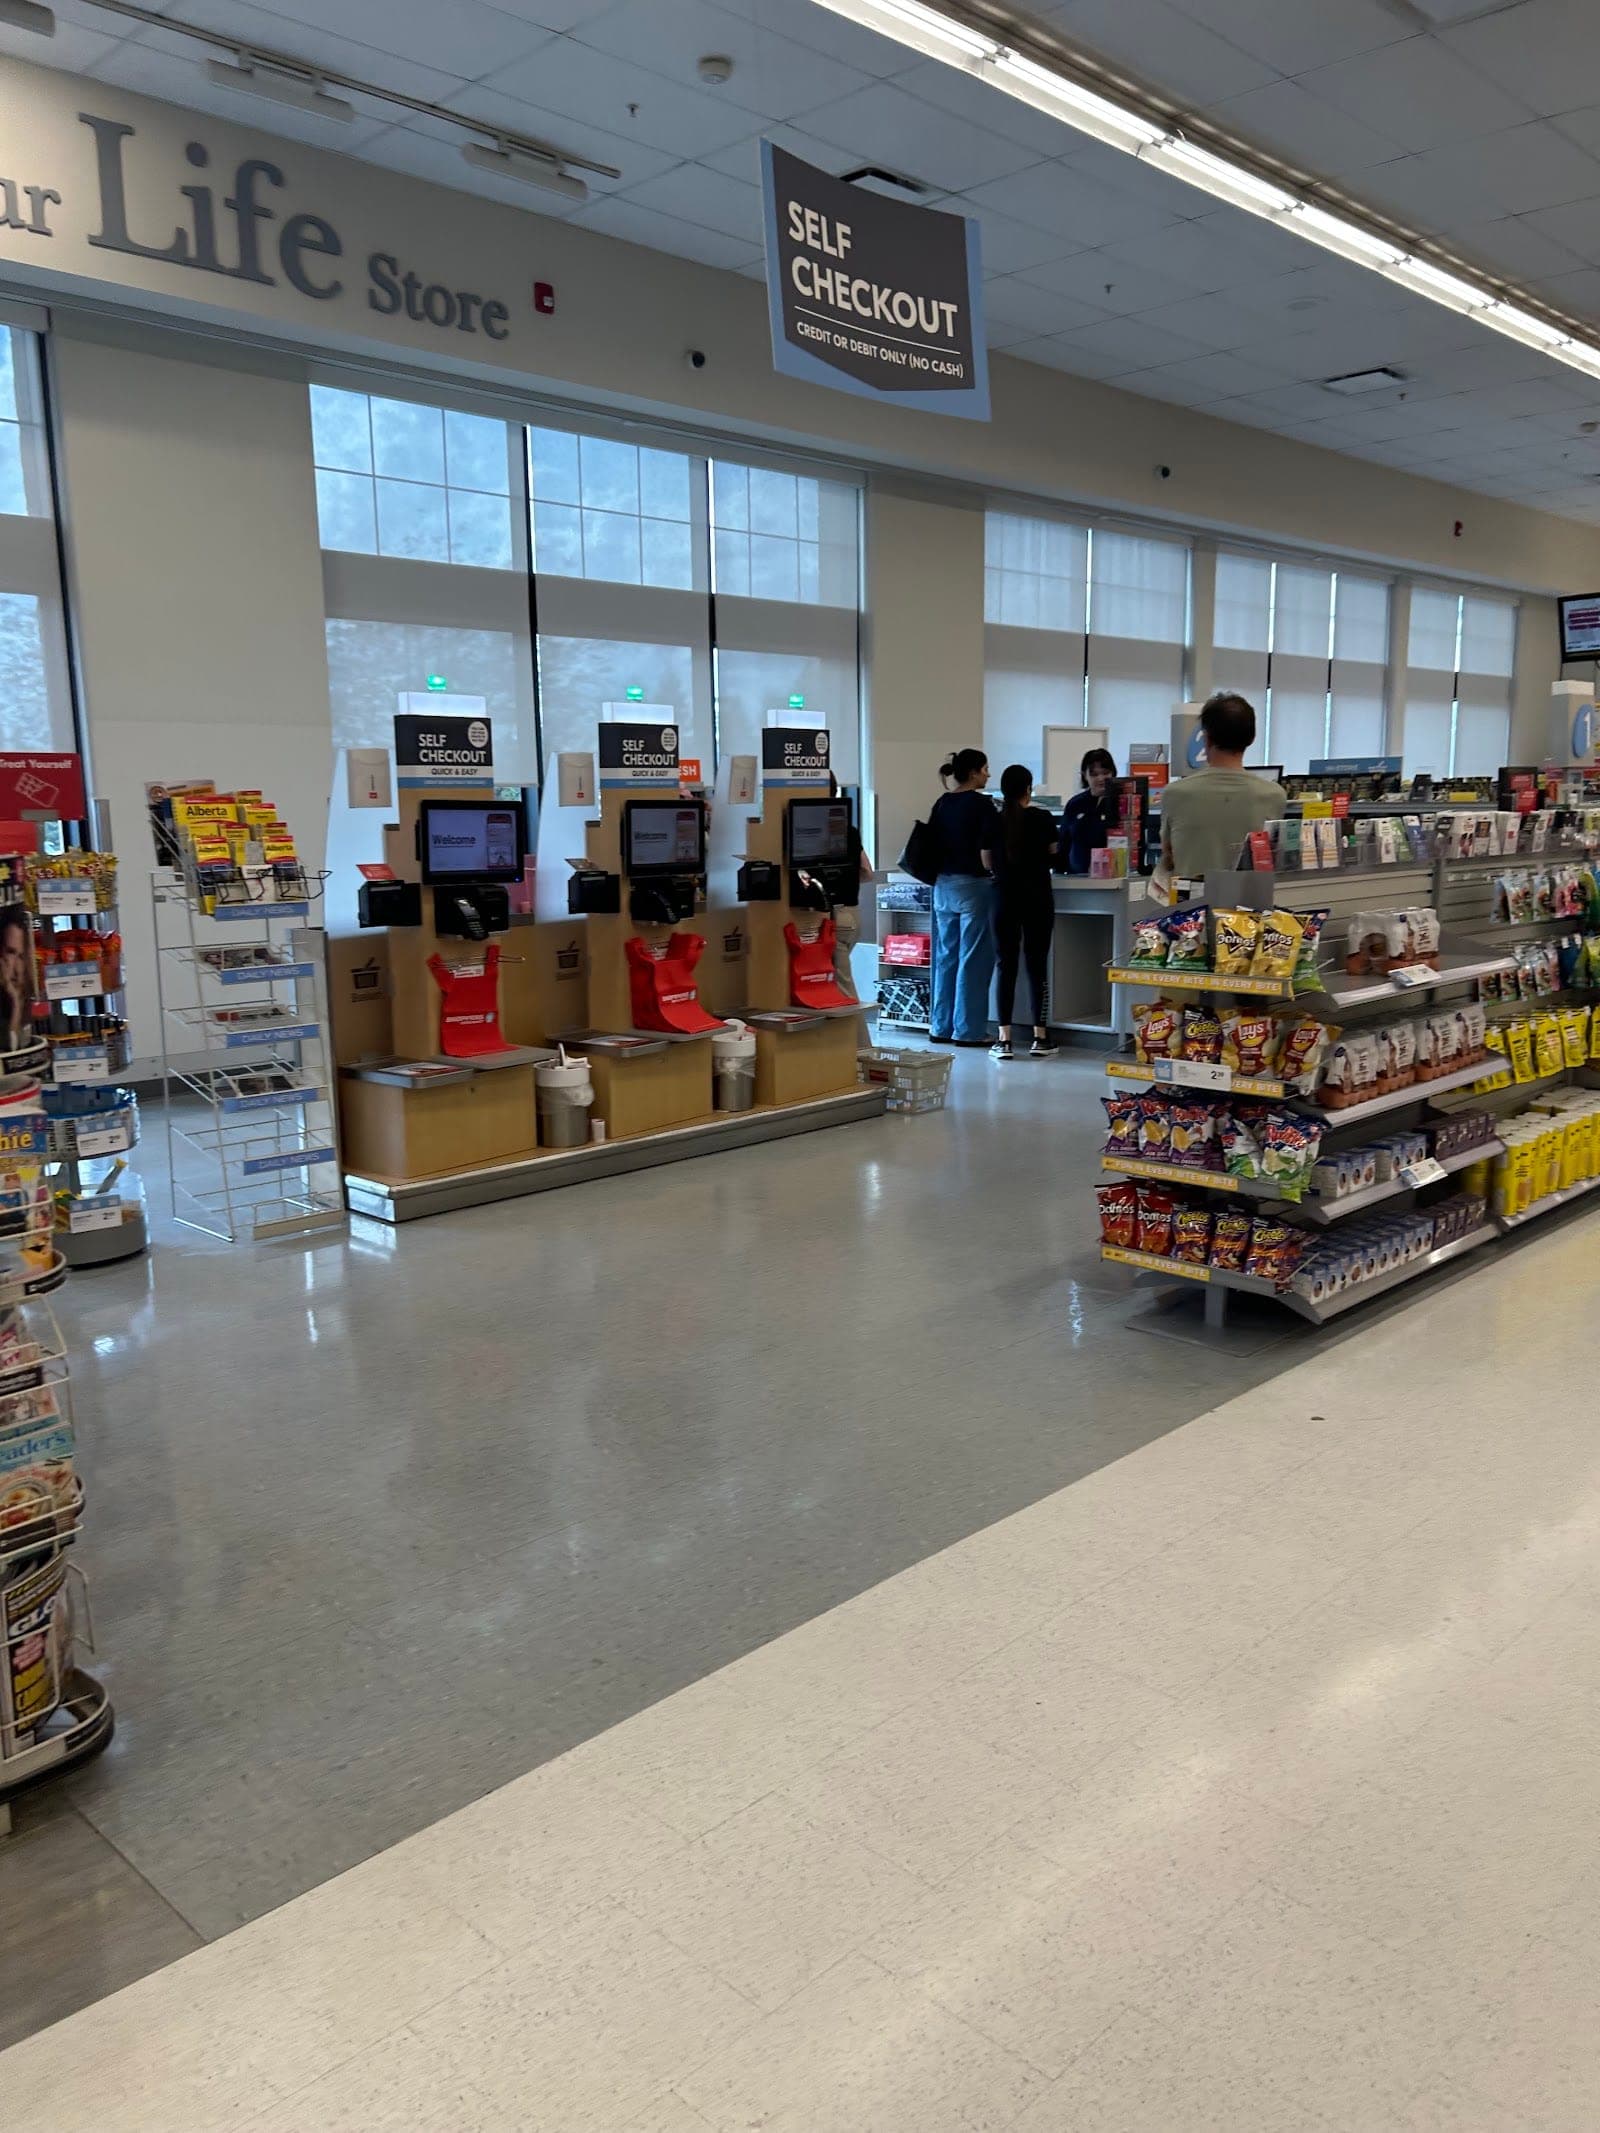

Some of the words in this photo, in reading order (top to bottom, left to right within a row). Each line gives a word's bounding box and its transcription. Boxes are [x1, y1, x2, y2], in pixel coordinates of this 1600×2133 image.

[79, 113, 342, 300] Life
[367, 252, 510, 340] Store
[787, 200, 852, 259] SELF
[791, 256, 958, 337] CHECKOUT
[796, 321, 832, 344] CREDIT
[833, 335, 848, 351] OR
[850, 339, 878, 359] DEBIT
[879, 348, 907, 365] ONLY
[909, 353, 929, 370] (NO
[931, 359, 964, 378] CASH)
[418, 733, 447, 747] SELF
[622, 739, 644, 751] SELF
[784, 742, 803, 754] SELF
[419, 750, 487, 764] CHECKOUT
[622, 753, 675, 766] CHECKOUT
[784, 755, 827, 767] CHECKOUT
[28, 759, 73, 769] Yourself
[431, 767, 453, 776] QUICK
[461, 768, 478, 776] EASY
[632, 769, 648, 777] QUICK
[186, 805, 228, 816] Alberta
[432, 835, 476, 846] Welcome
[1153, 975, 1180, 983] EVERY
[1184, 977, 1205, 985] BITE
[242, 1034, 269, 1044] DAILY
[259, 1157, 286, 1169] DAILY
